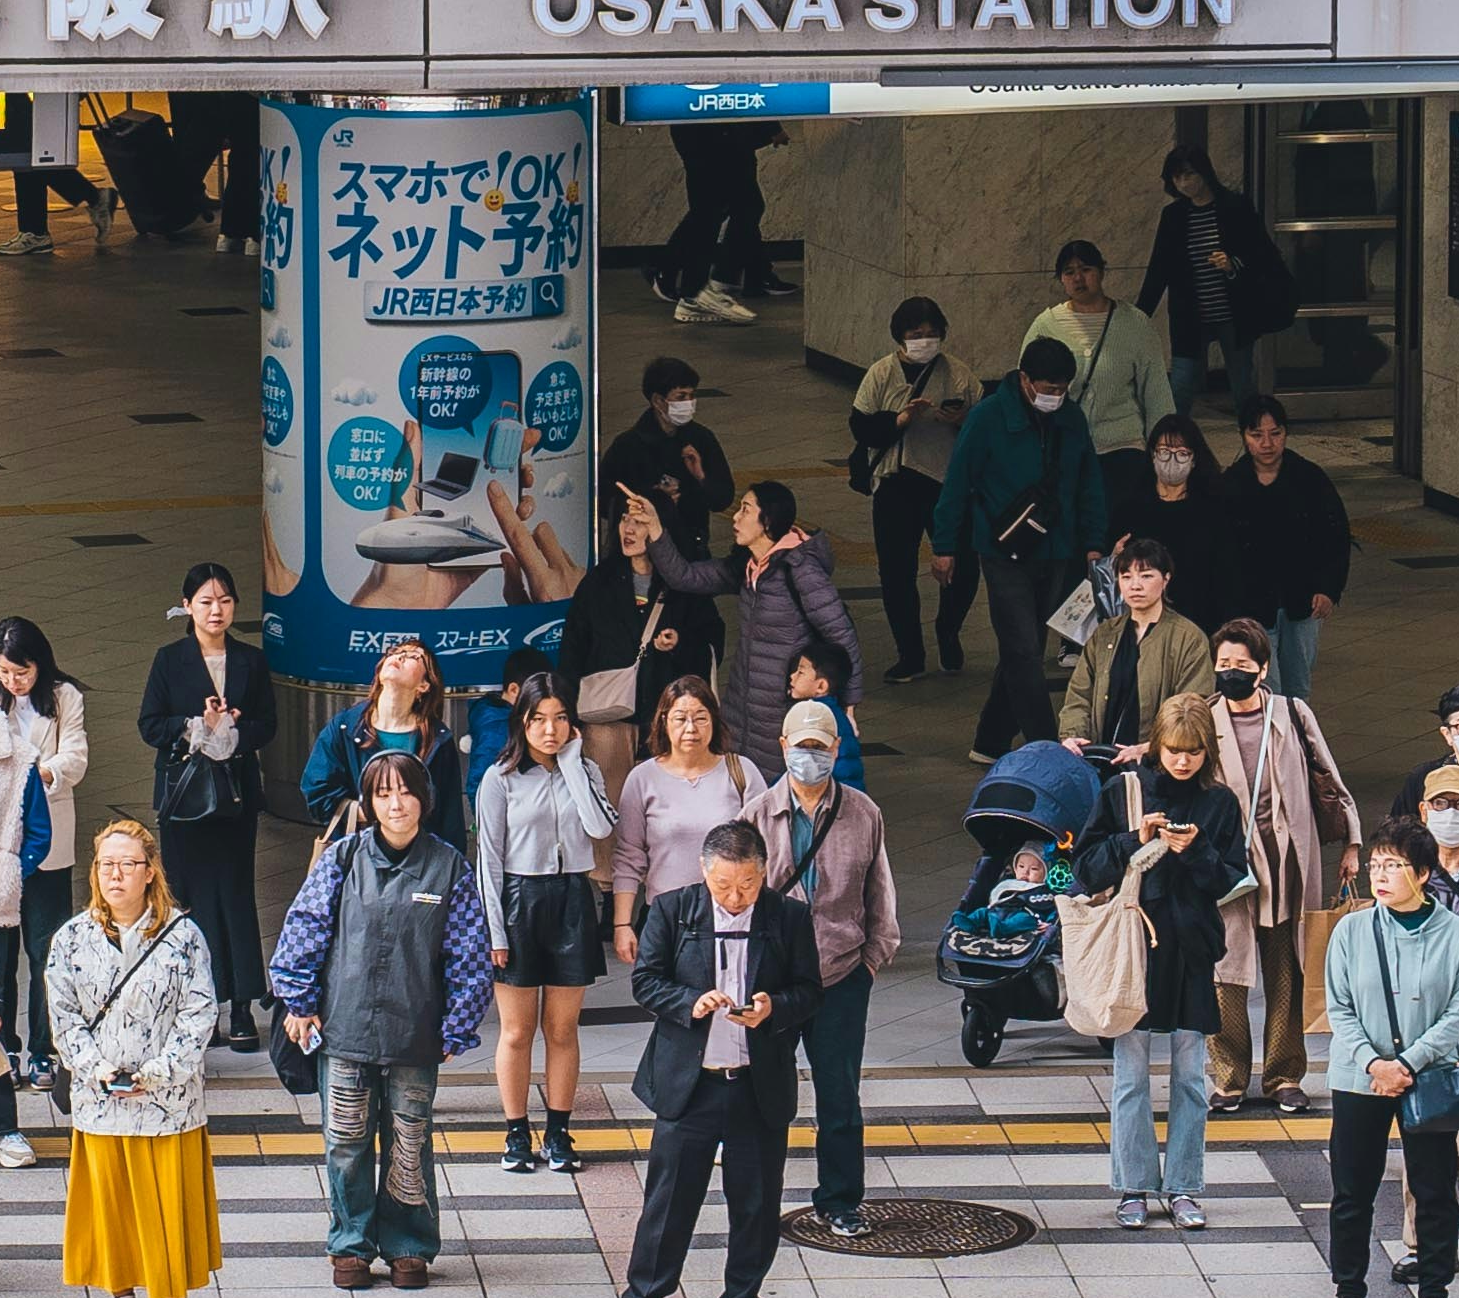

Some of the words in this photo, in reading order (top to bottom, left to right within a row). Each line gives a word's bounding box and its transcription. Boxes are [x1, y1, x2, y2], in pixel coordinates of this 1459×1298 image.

[689, 93, 766, 112] JR西日本
[332, 129, 354, 144] JR
[328, 196, 584, 280] ネット予約
[372, 283, 527, 317] JR西日本予約
[420, 352, 473, 362] EXサービスなら
[419, 367, 472, 382] 新幹線の
[549, 372, 567, 386] 急な
[409, 384, 481, 400] 1年前予約が
[534, 388, 578, 408] 予定変更や
[429, 403, 458, 418] OK!
[532, 406, 579, 426] 払いもどしも
[350, 428, 386, 444] 窓口に
[548, 425, 568, 442] OK!
[348, 447, 386, 463] 並ばず
[334, 464, 407, 483] 列車の予約が
[353, 485, 382, 501] OK!
[434, 628, 511, 647] スマートEX
